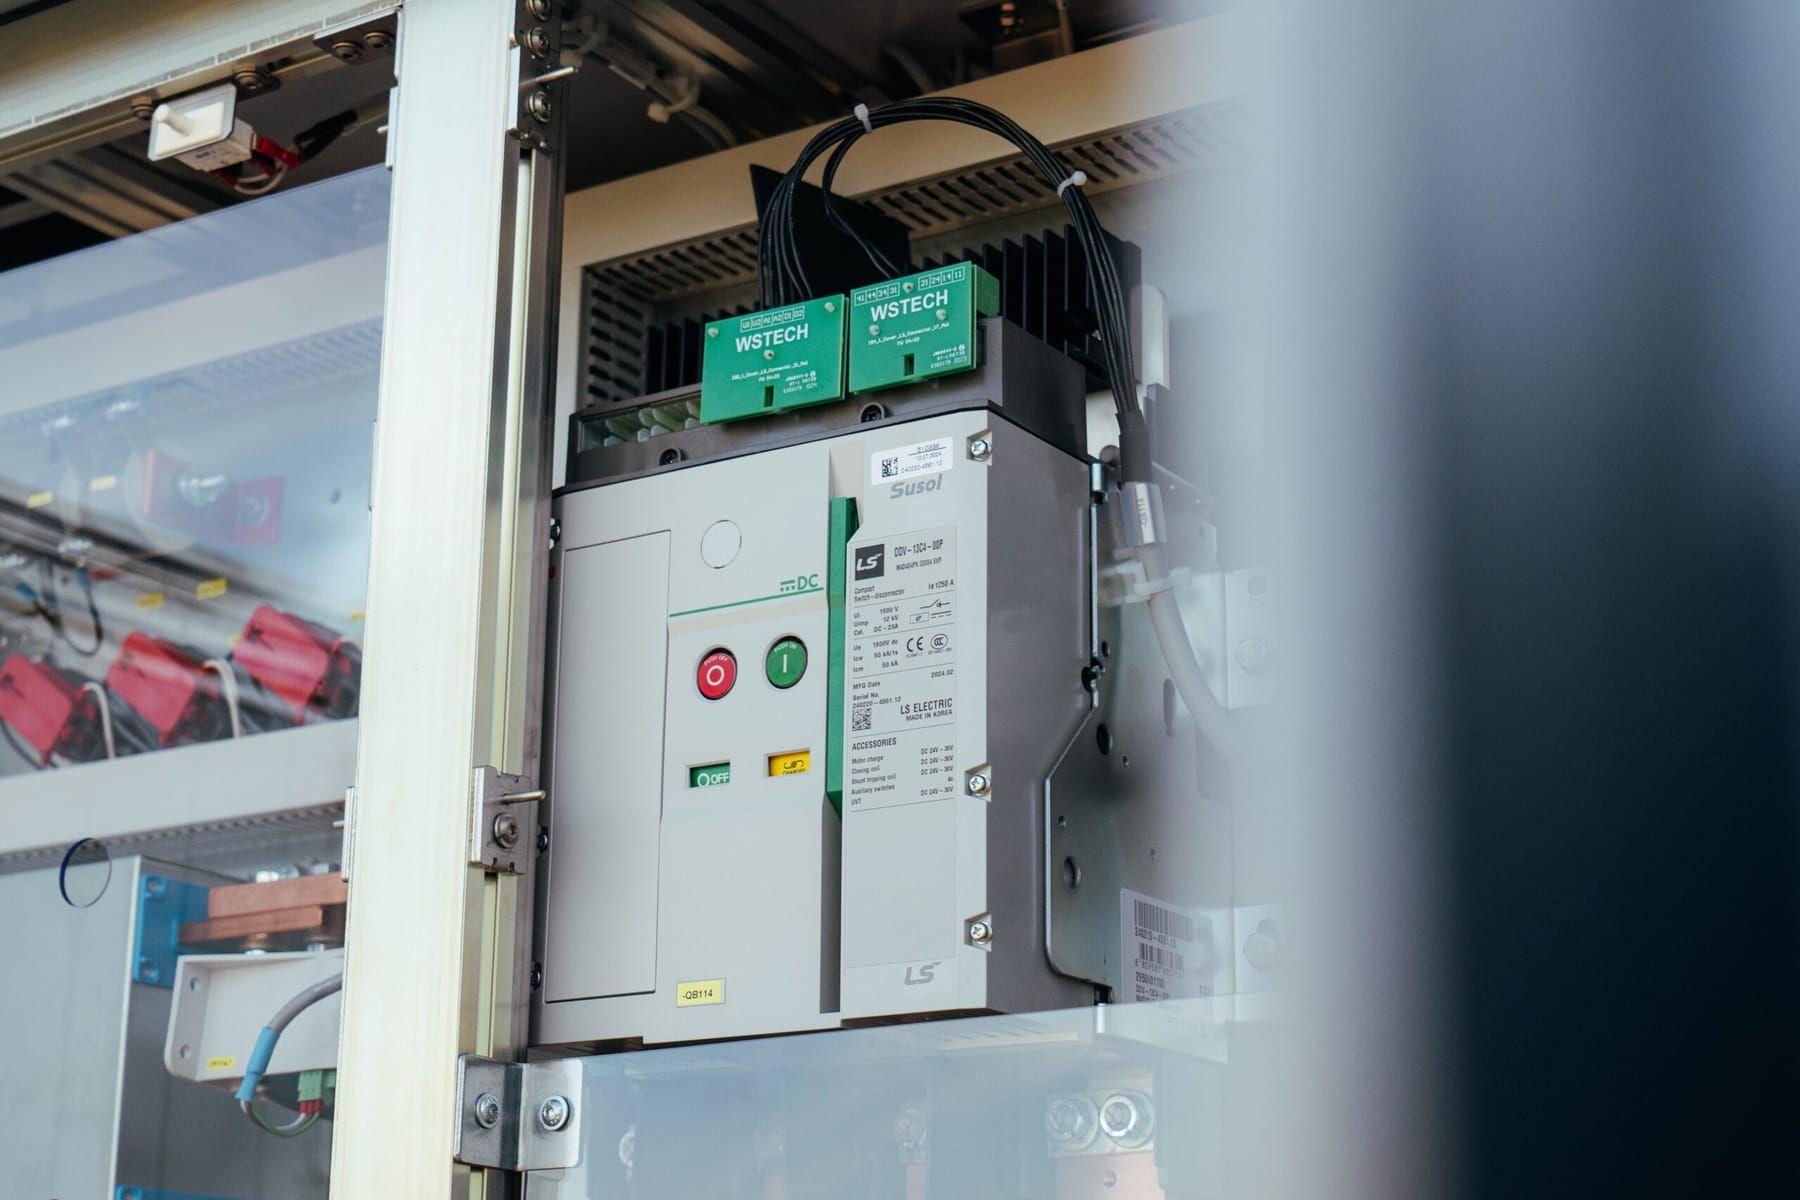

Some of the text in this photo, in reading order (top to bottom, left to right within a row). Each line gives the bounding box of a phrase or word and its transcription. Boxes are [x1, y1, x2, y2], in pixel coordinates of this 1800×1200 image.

[920, 278, 929, 287] 21
[931, 276, 940, 284] 24
[954, 270, 962, 279] 11
[878, 288, 887, 297] 34
[889, 286, 898, 294] 31
[870, 289, 948, 322] WSTECH
[736, 324, 808, 353] WSTECH
[890, 474, 943, 499] Susol
[856, 552, 882, 571] LS
[798, 573, 818, 590] DC
[935, 580, 948, 588] 1250
[854, 586, 875, 595] Compact
[906, 636, 924, 652] CE
[853, 682, 866, 690] MFG
[931, 669, 954, 678] 2024.02
[853, 693, 869, 701] Serial
[900, 698, 952, 715] LS ELECTRIC
[906, 713, 922, 721] MADE
[933, 709, 952, 717] KOREA
[852, 737, 897, 751] ACCESSORIES
[867, 755, 884, 763] charge
[852, 767, 870, 775] Closing
[710, 772, 729, 784] OFF
[867, 775, 886, 783] tripping
[851, 787, 872, 795] Auxiliary
[874, 784, 895, 792] switches
[904, 962, 940, 986] LS
[682, 990, 713, 1000] -QB114
